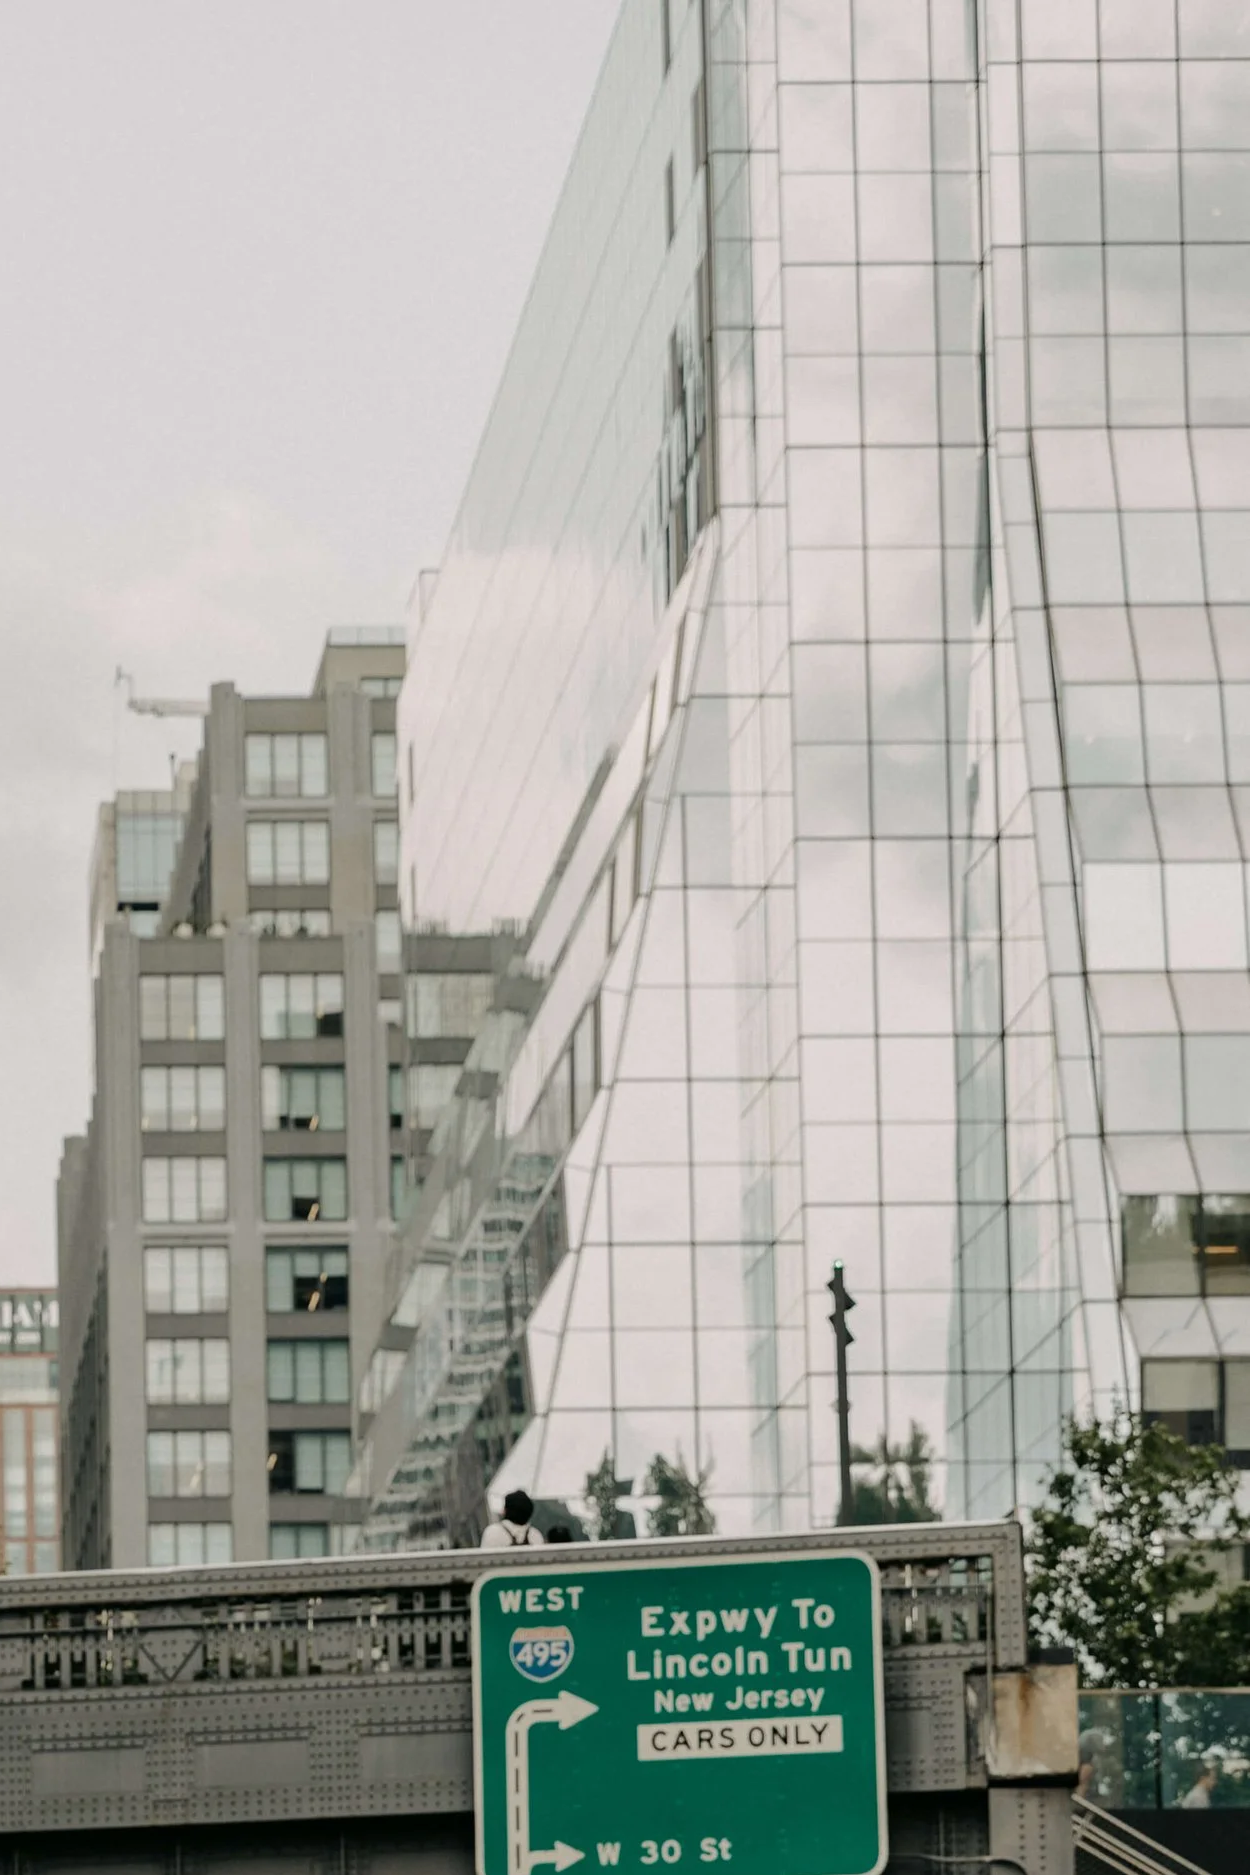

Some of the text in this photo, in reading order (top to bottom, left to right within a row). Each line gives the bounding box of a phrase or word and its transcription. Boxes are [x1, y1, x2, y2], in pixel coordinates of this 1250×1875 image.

[498, 1586, 584, 1614] WEST
[641, 1598, 835, 1641] Expwy To
[516, 1641, 567, 1668] 495
[627, 1641, 852, 1681] Lincoln Tun
[654, 1686, 825, 1714] New Jersey
[652, 1723, 829, 1751] CARS ONLY
[596, 1837, 732, 1866] W 30 St
